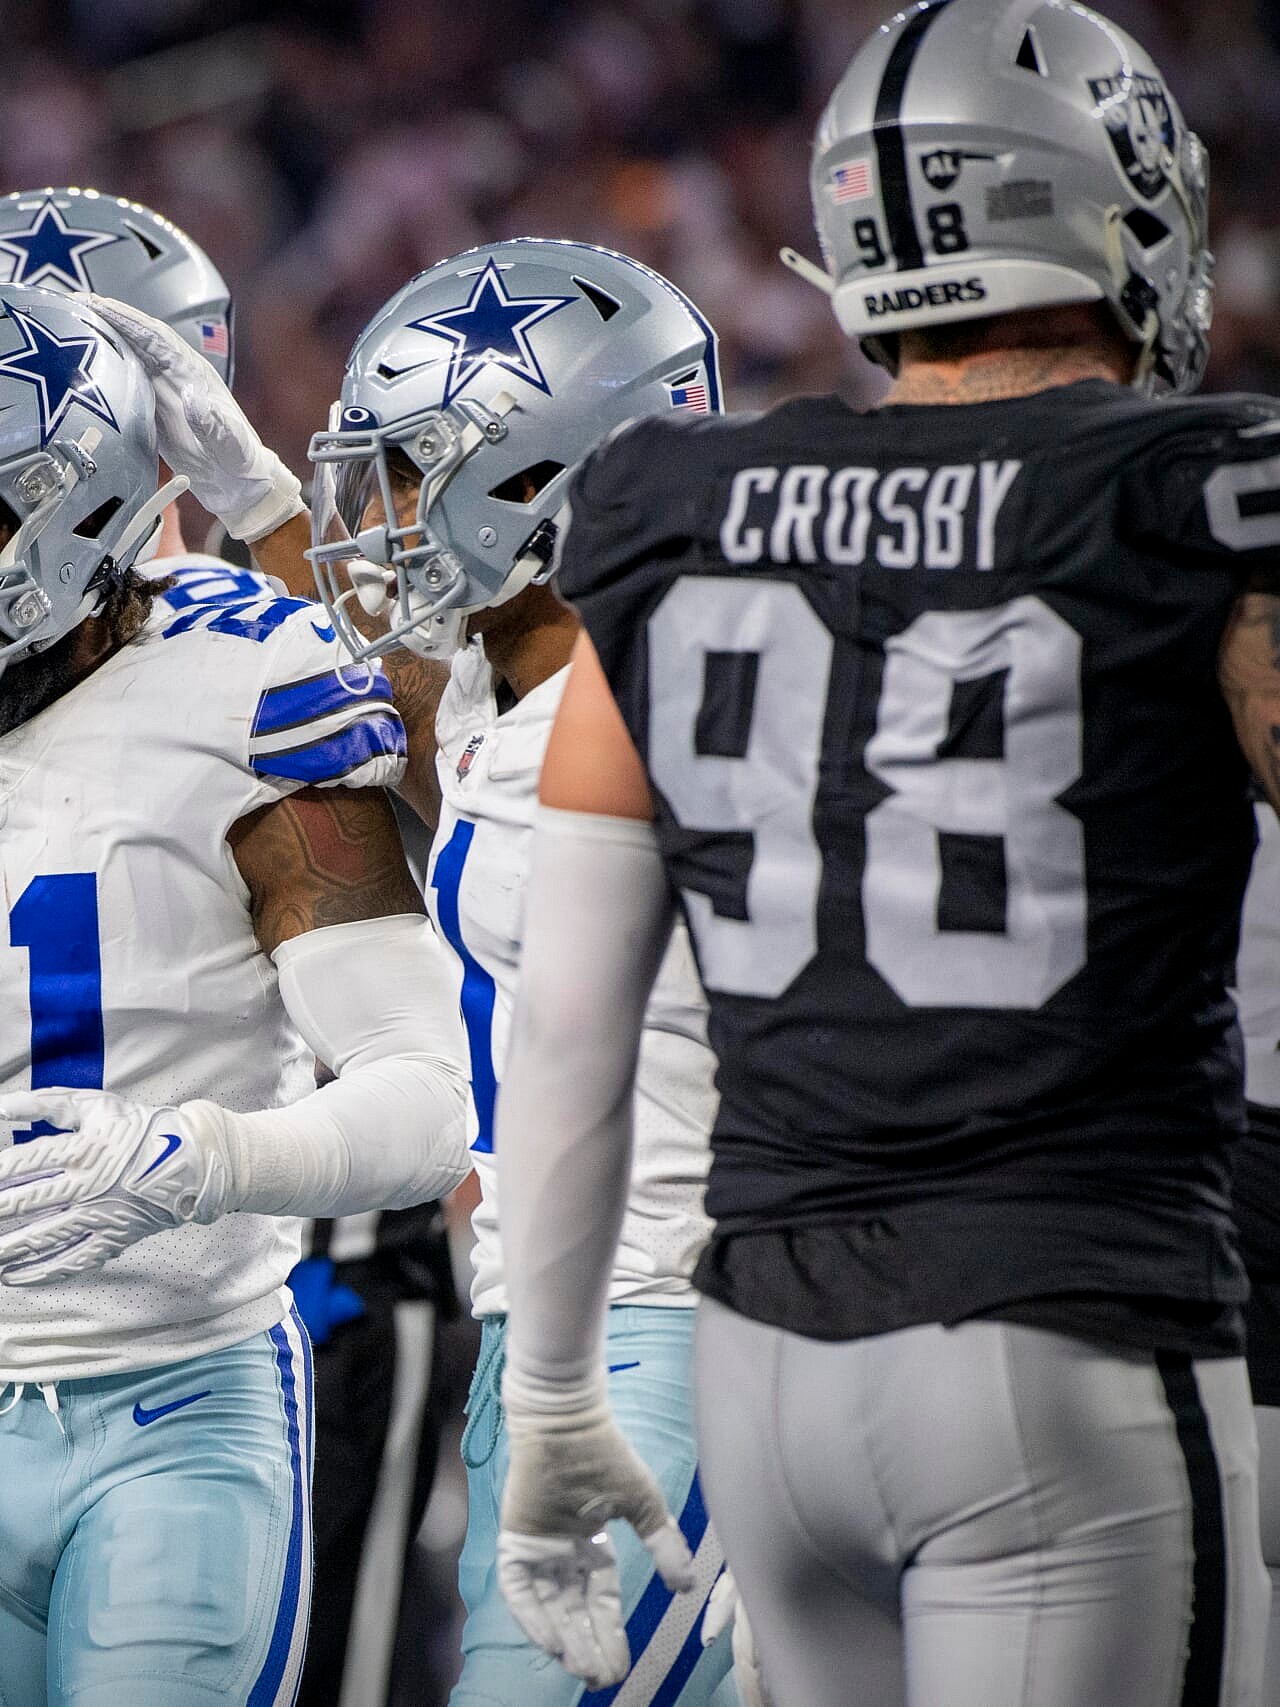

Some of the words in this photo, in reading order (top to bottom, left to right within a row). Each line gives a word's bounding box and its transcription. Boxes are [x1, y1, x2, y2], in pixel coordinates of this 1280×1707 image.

[864, 278, 987, 319] RAIDERS
[721, 459, 1023, 571] CROSBY
[647, 575, 1088, 1011] 98
